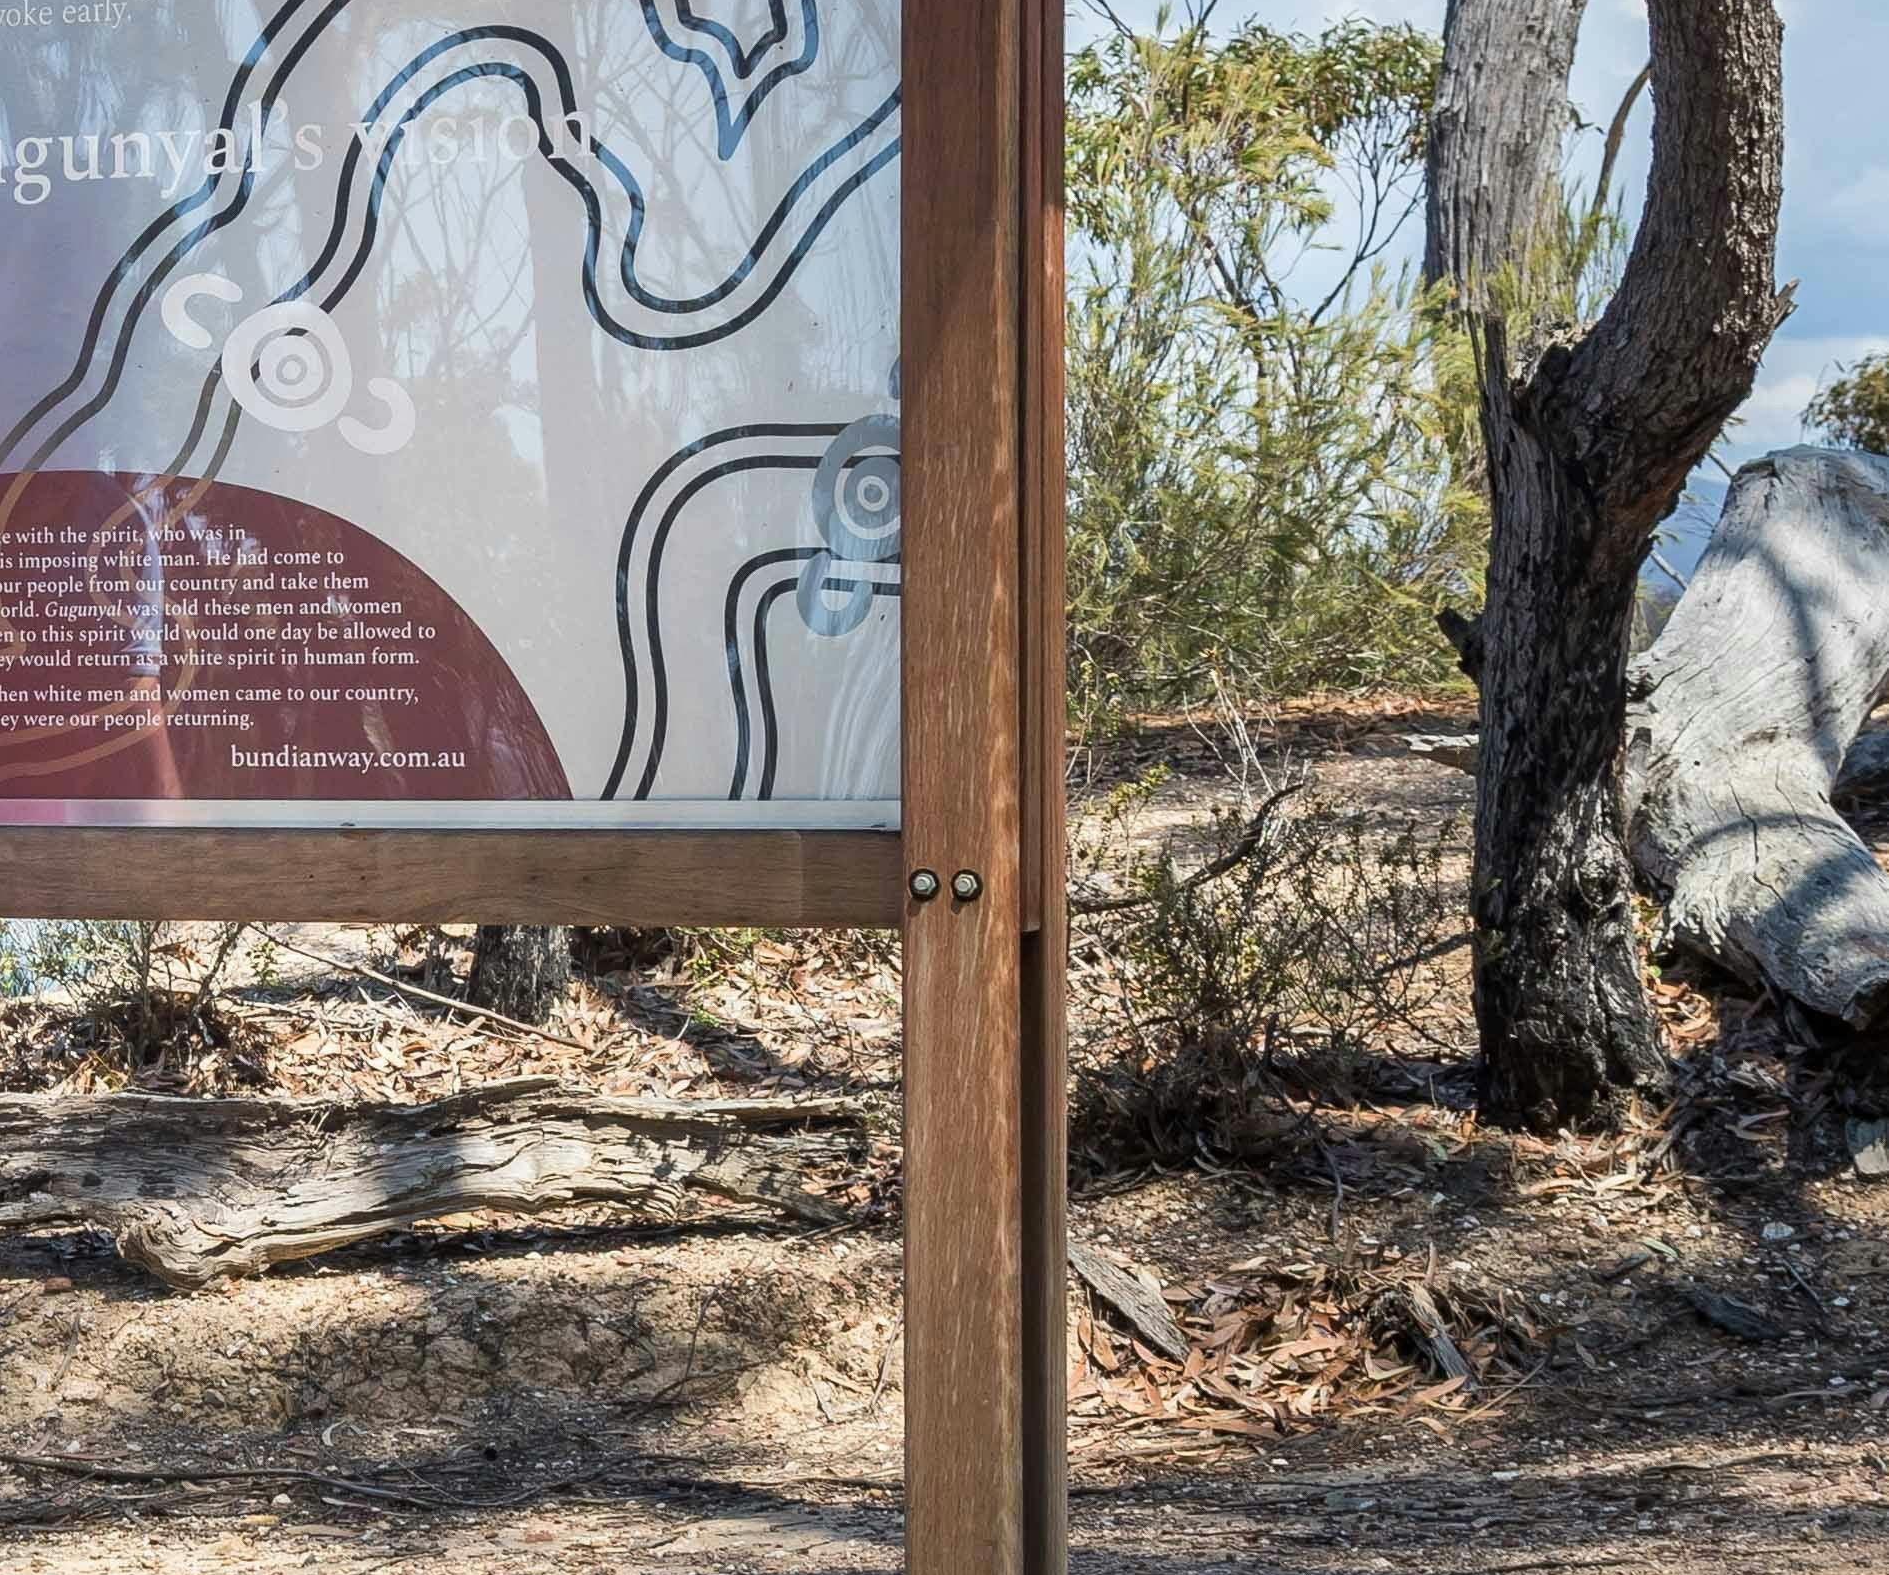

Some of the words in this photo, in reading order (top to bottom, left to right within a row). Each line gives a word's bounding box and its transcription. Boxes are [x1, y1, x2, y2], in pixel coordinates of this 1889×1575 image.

[348, 109, 597, 167] vision
[15, 526, 55, 544] with
[59, 526, 87, 543] the
[91, 525, 144, 548] spirit,
[149, 524, 185, 542] who
[190, 528, 223, 541] was
[228, 523, 245, 540] in
[18, 551, 99, 573] imposing
[103, 550, 151, 567] white
[158, 554, 200, 567] man.
[207, 550, 231, 566] He
[237, 548, 268, 566] had
[273, 552, 321, 565] come
[325, 549, 345, 564] to
[19, 627, 37, 642] to
[41, 624, 73, 642] this
[79, 625, 125, 646] spirit
[131, 624, 179, 641] world
[185, 623, 239, 641] would
[244, 628, 277, 640] one
[281, 623, 313, 645] day
[317, 623, 338, 640] be
[343, 622, 413, 640] allowed
[418, 624, 437, 639] to
[19, 649, 71, 667] would
[77, 651, 131, 666] return
[135, 654, 153, 666] as
[159, 654, 168, 666] a
[173, 648, 223, 666] white
[227, 648, 276, 670] spirit
[281, 648, 299, 665] in
[303, 648, 369, 665] human
[371, 647, 419, 664] form.
[33, 685, 83, 702] white
[87, 689, 125, 702] men
[129, 684, 161, 702] and
[167, 689, 230, 701] women
[235, 689, 282, 701] came
[287, 686, 305, 701] to
[309, 688, 341, 701] our
[345, 685, 419, 705] country,
[23, 714, 65, 726] were
[69, 714, 100, 726] our
[104, 709, 161, 731] people
[166, 709, 255, 731] returning.
[231, 744, 466, 774] bundianway.com.au
